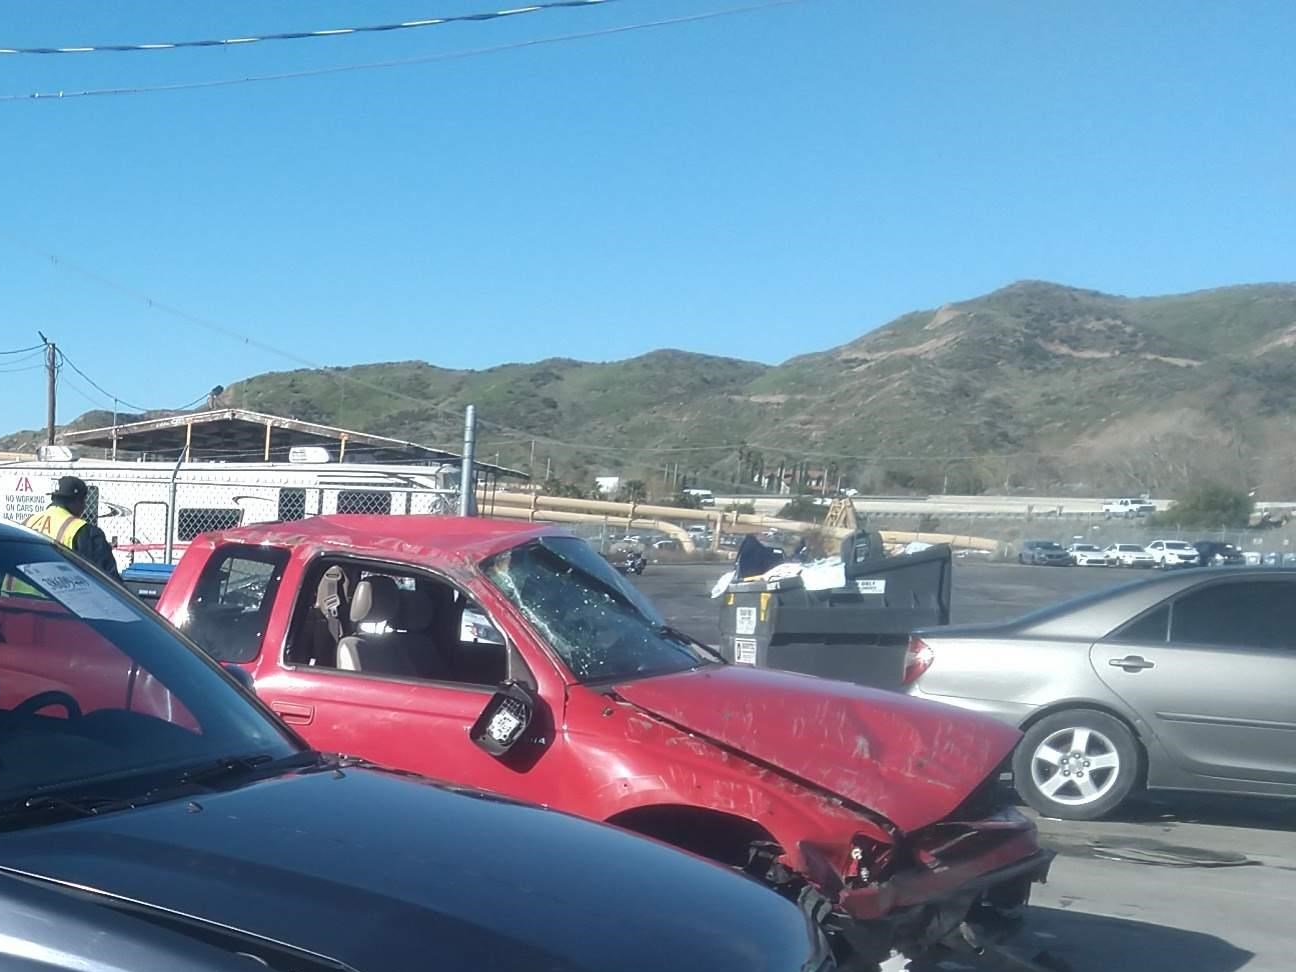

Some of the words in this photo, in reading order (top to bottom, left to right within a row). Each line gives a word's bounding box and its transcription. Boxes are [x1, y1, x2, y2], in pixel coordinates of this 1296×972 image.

[5, 494, 15, 503] NO
[15, 495, 46, 504] WORKING
[5, 503, 15, 512] ON
[16, 503, 34, 513] CARS
[34, 504, 45, 513] ON
